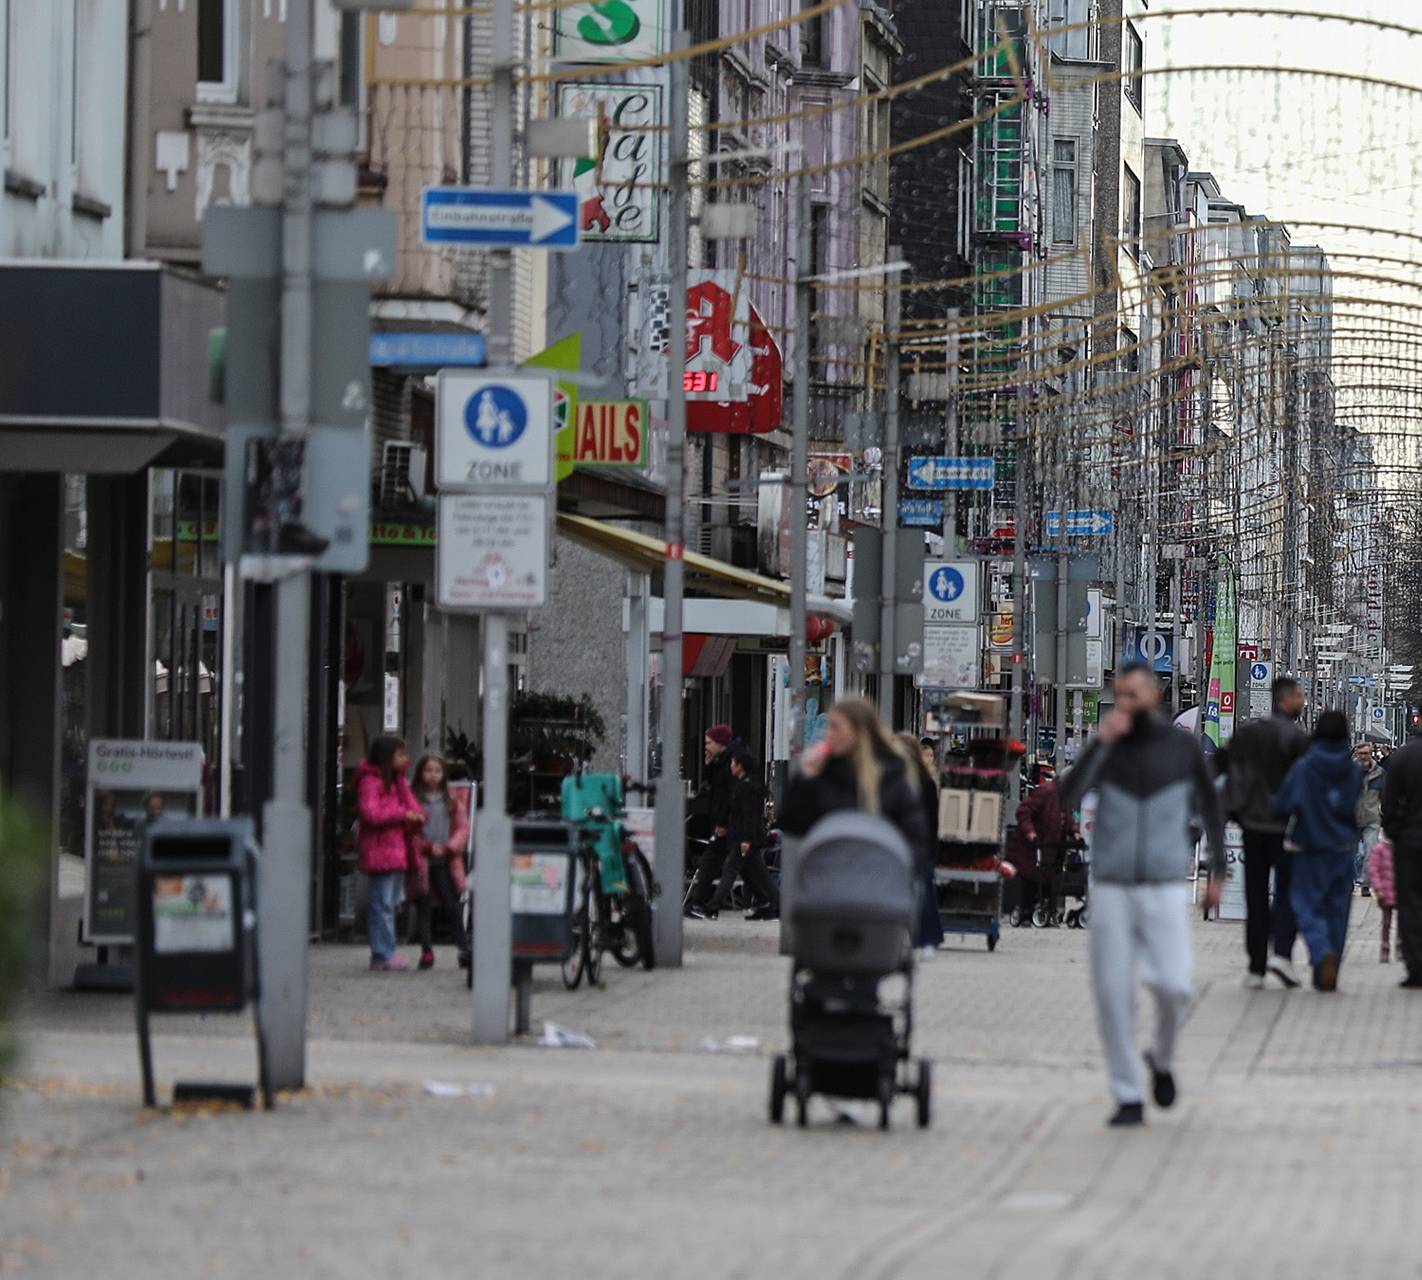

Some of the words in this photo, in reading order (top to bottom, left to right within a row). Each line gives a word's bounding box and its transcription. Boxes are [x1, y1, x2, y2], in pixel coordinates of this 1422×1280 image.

[429, 210, 535, 224] Einbahnstraße
[574, 403, 641, 462] AILS
[467, 462, 523, 480] ZONE
[930, 608, 961, 619] ZONE
